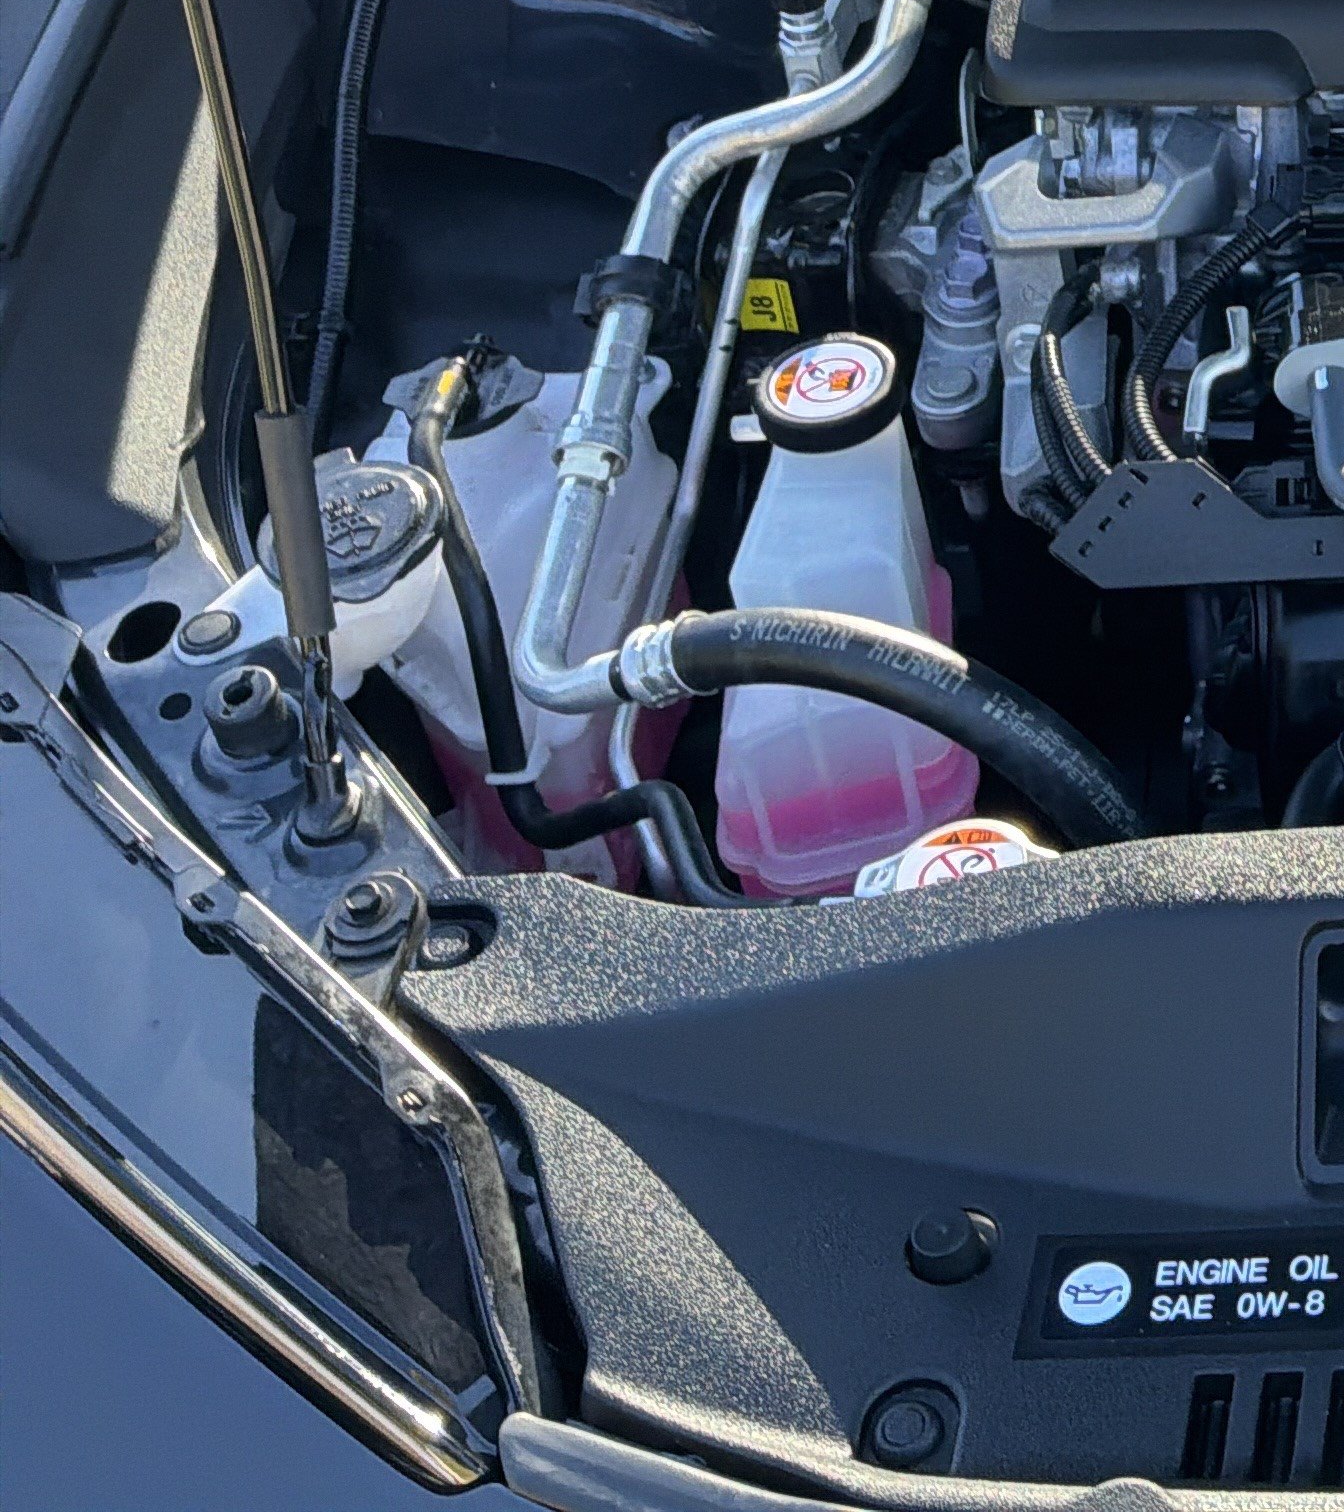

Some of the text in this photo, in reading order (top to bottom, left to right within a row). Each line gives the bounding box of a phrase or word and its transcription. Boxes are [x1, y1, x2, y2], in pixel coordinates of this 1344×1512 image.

[750, 295, 777, 322] J8
[1155, 1254, 1340, 1286] ENGINE OIL
[1150, 1290, 1326, 1322] SAE 0W-8
